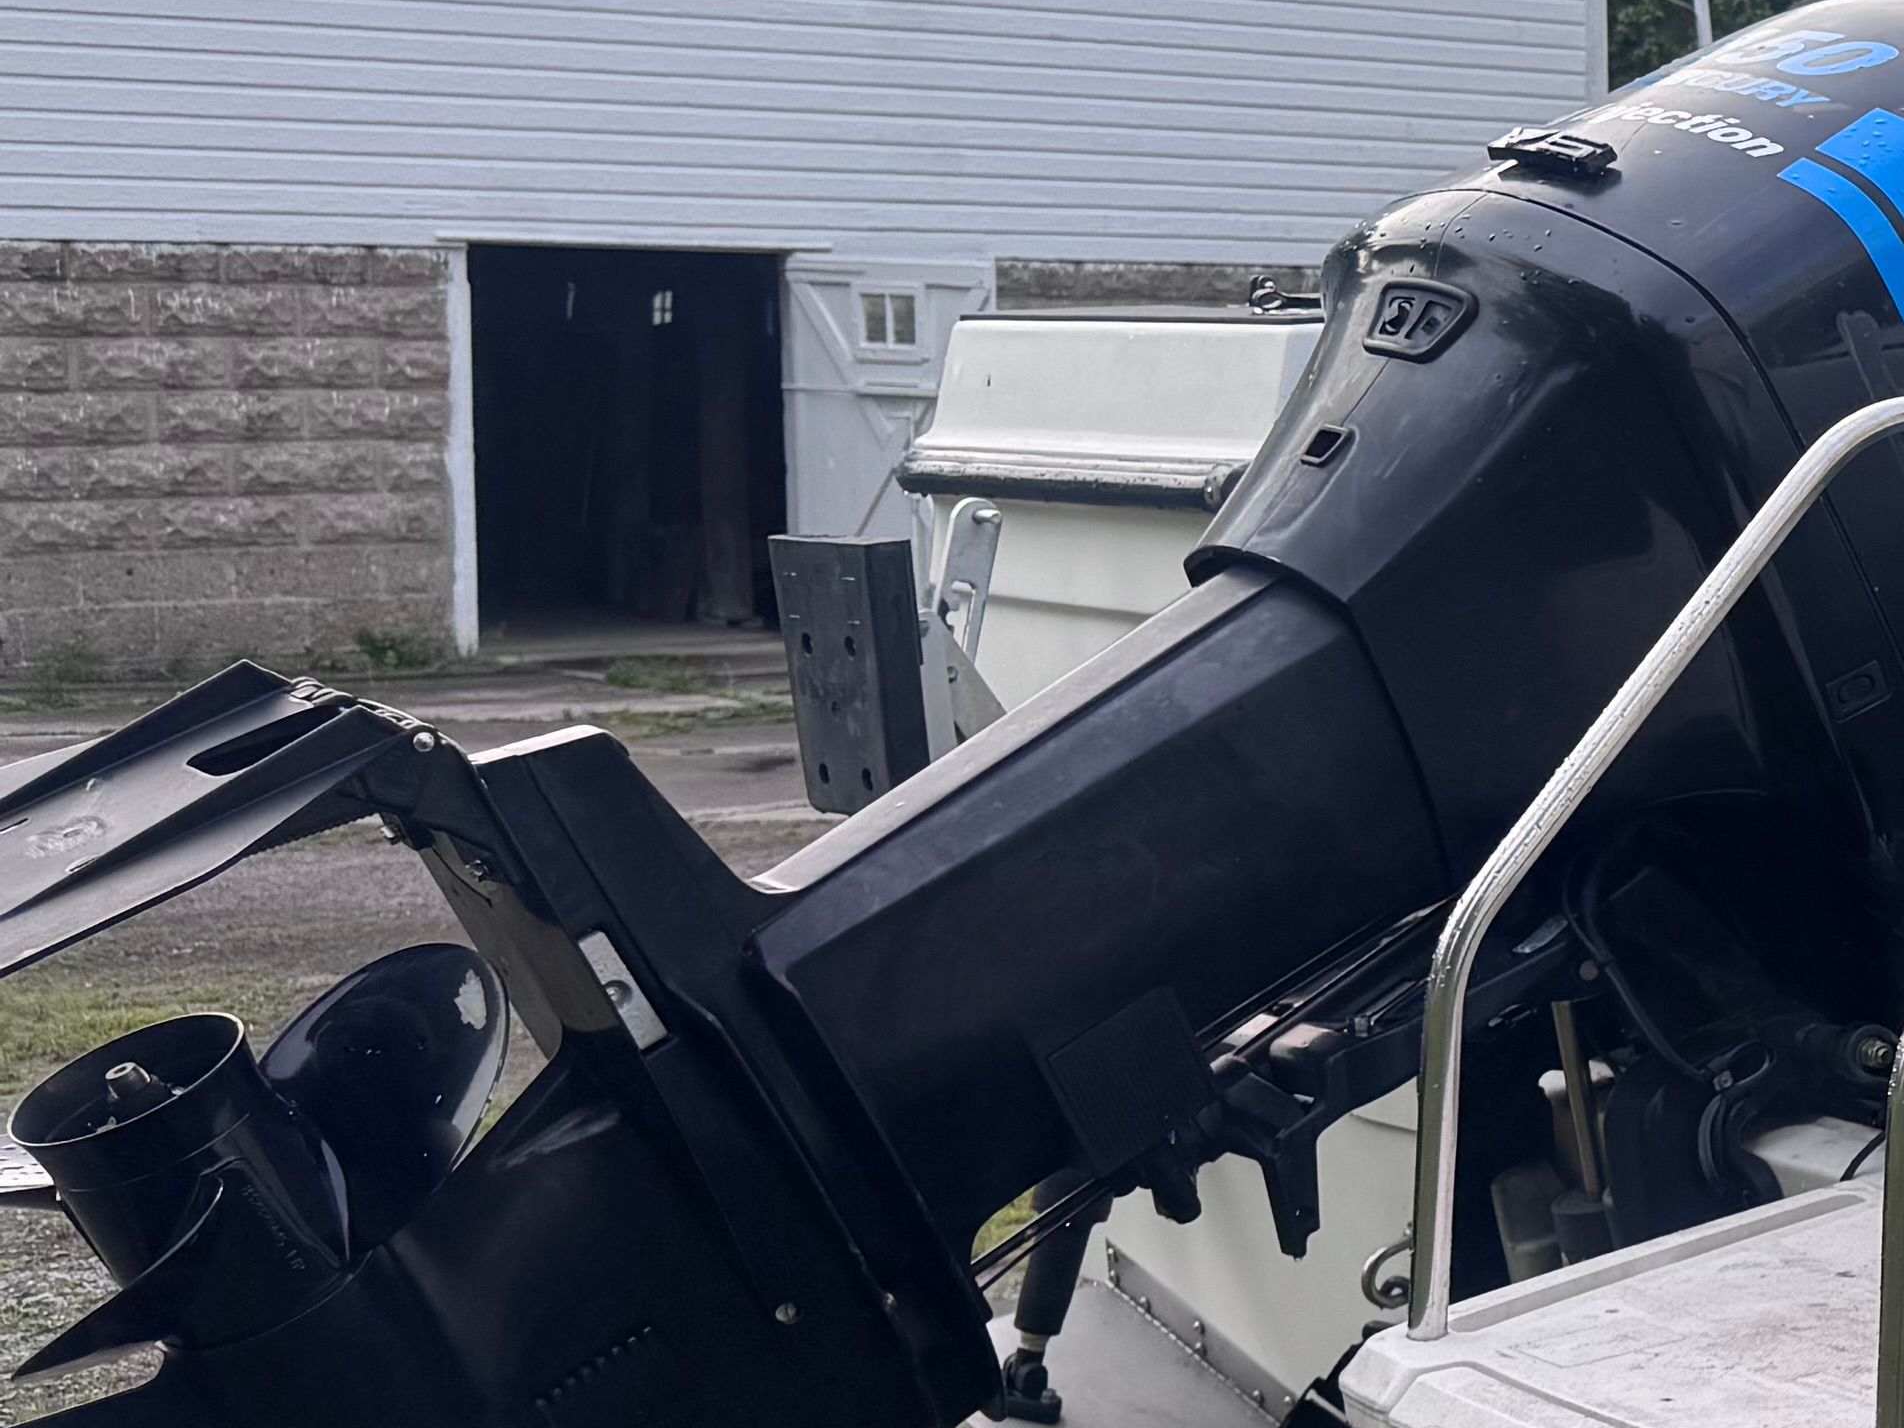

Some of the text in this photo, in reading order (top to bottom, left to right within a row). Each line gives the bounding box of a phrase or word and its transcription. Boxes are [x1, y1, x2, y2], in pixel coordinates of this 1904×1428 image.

[1715, 29, 1899, 75] 50
[1668, 69, 1830, 107] CURY
[1580, 102, 1785, 158] jection
